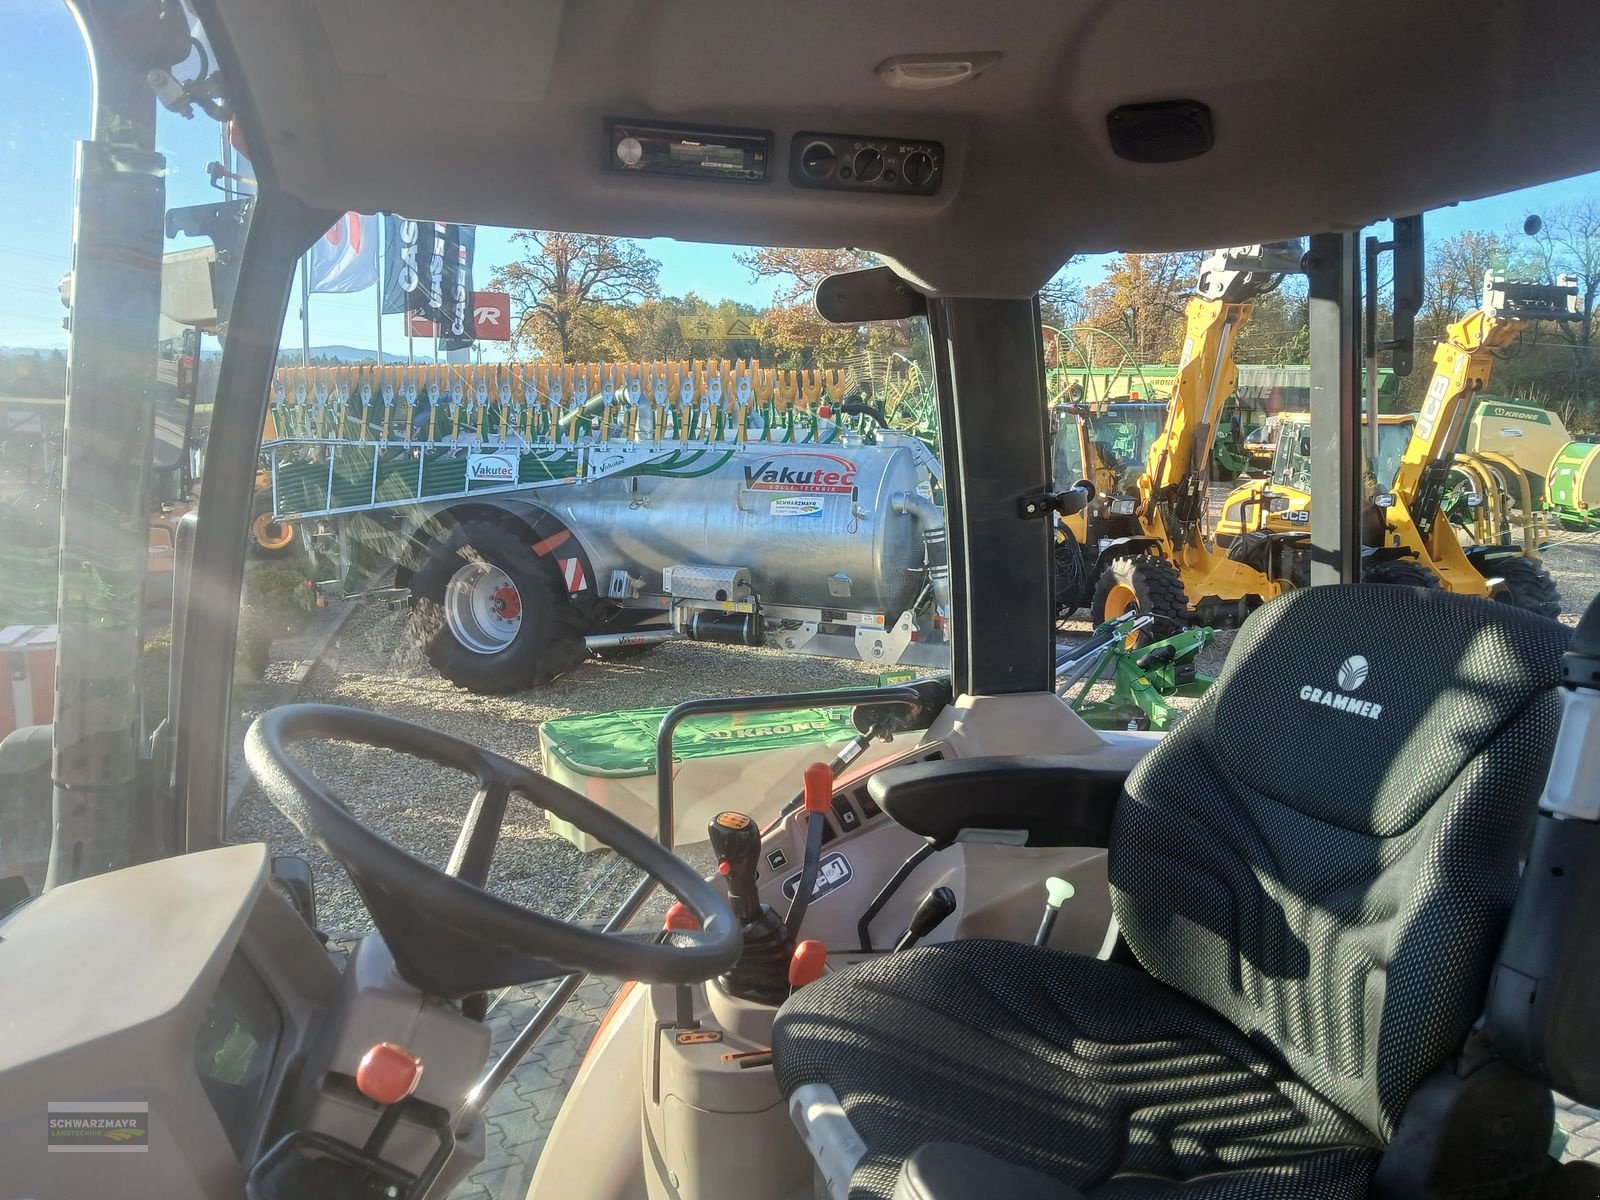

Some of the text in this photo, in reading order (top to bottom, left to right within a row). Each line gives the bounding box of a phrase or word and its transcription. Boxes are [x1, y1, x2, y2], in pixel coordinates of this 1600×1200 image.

[398, 220, 419, 292] CAS
[1416, 375, 1451, 441] JCB
[1504, 410, 1540, 421] KRONE
[472, 462, 513, 478] Vakutec
[599, 458, 627, 473] Vakutec
[743, 461, 857, 490] Vakutec
[1281, 511, 1310, 522] JCB
[1299, 684, 1383, 720] GRAMMER
[736, 721, 826, 738] KRONE
